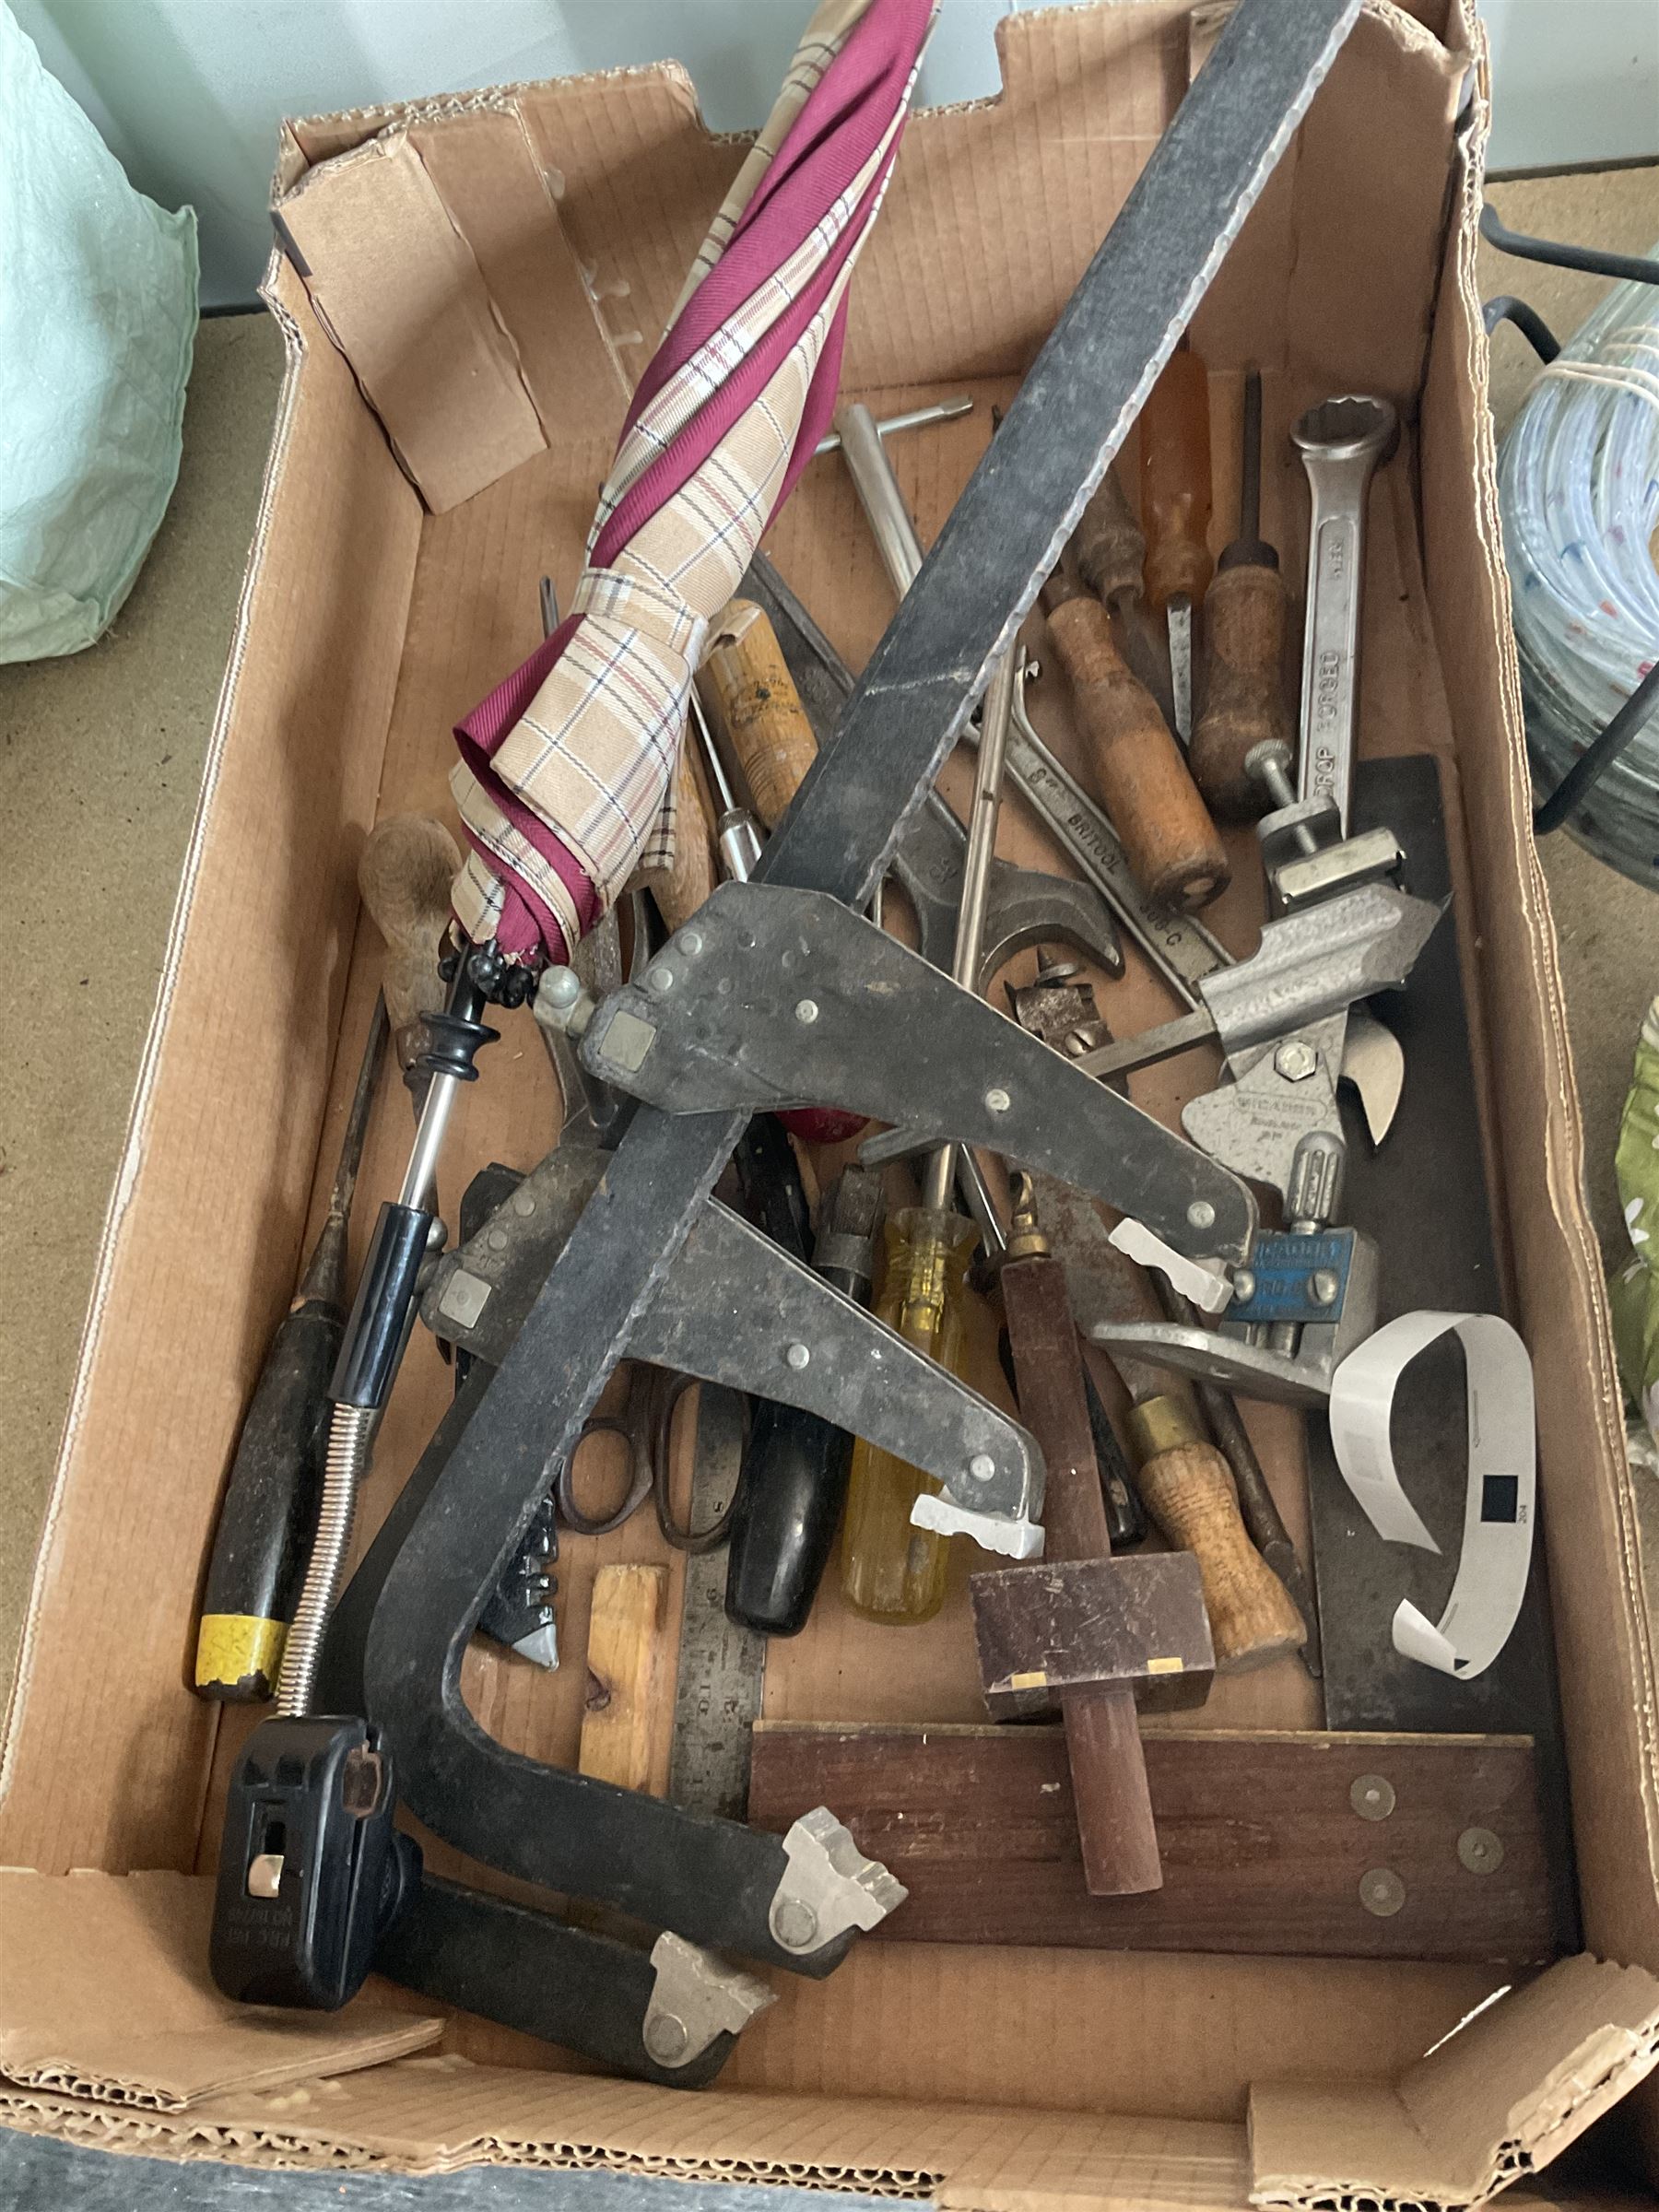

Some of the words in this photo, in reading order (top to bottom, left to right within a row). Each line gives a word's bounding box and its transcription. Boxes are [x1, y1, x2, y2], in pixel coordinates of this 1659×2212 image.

[1316, 650, 1340, 733] FORGED
[1312, 746, 1335, 801] DROP
[1067, 813, 1122, 876] BRITOOL
